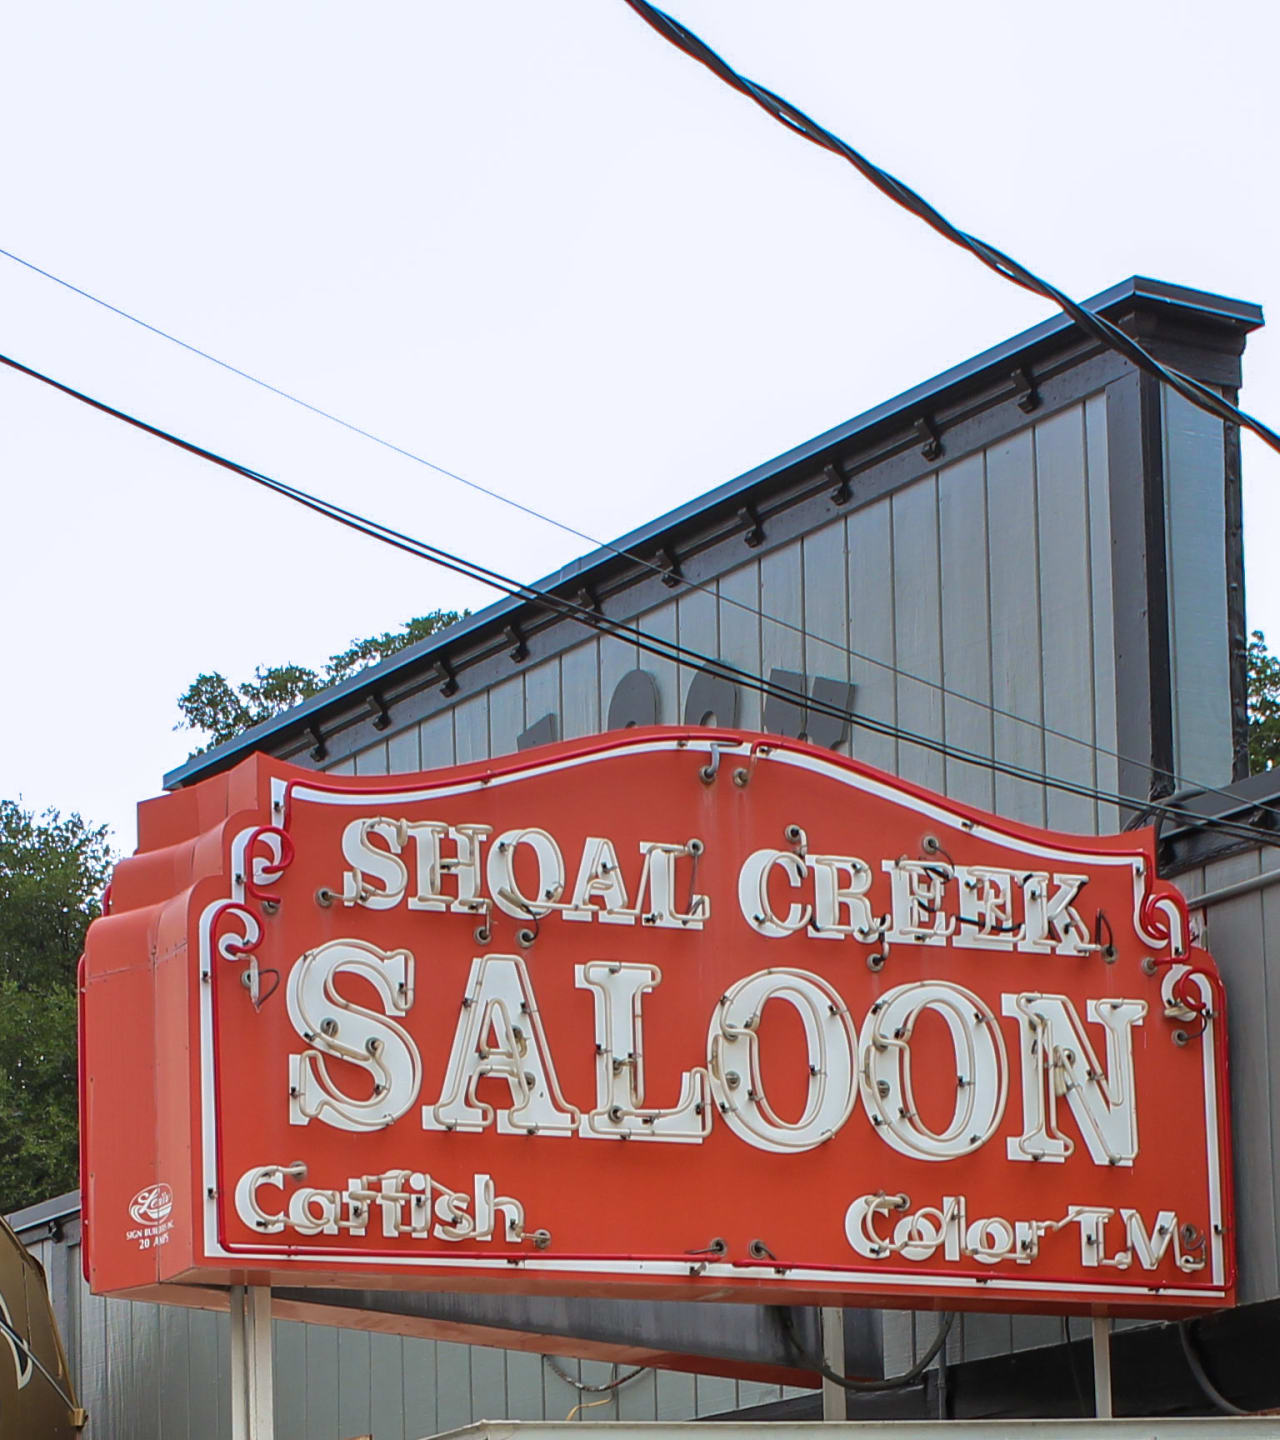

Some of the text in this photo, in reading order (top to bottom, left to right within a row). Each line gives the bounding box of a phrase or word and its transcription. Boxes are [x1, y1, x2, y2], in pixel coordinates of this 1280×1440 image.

[341, 815, 1091, 958] SHOAL CREEK
[286, 938, 1149, 1167] SALOON
[234, 1165, 525, 1243] Catfish
[845, 1193, 1045, 1265] Color
